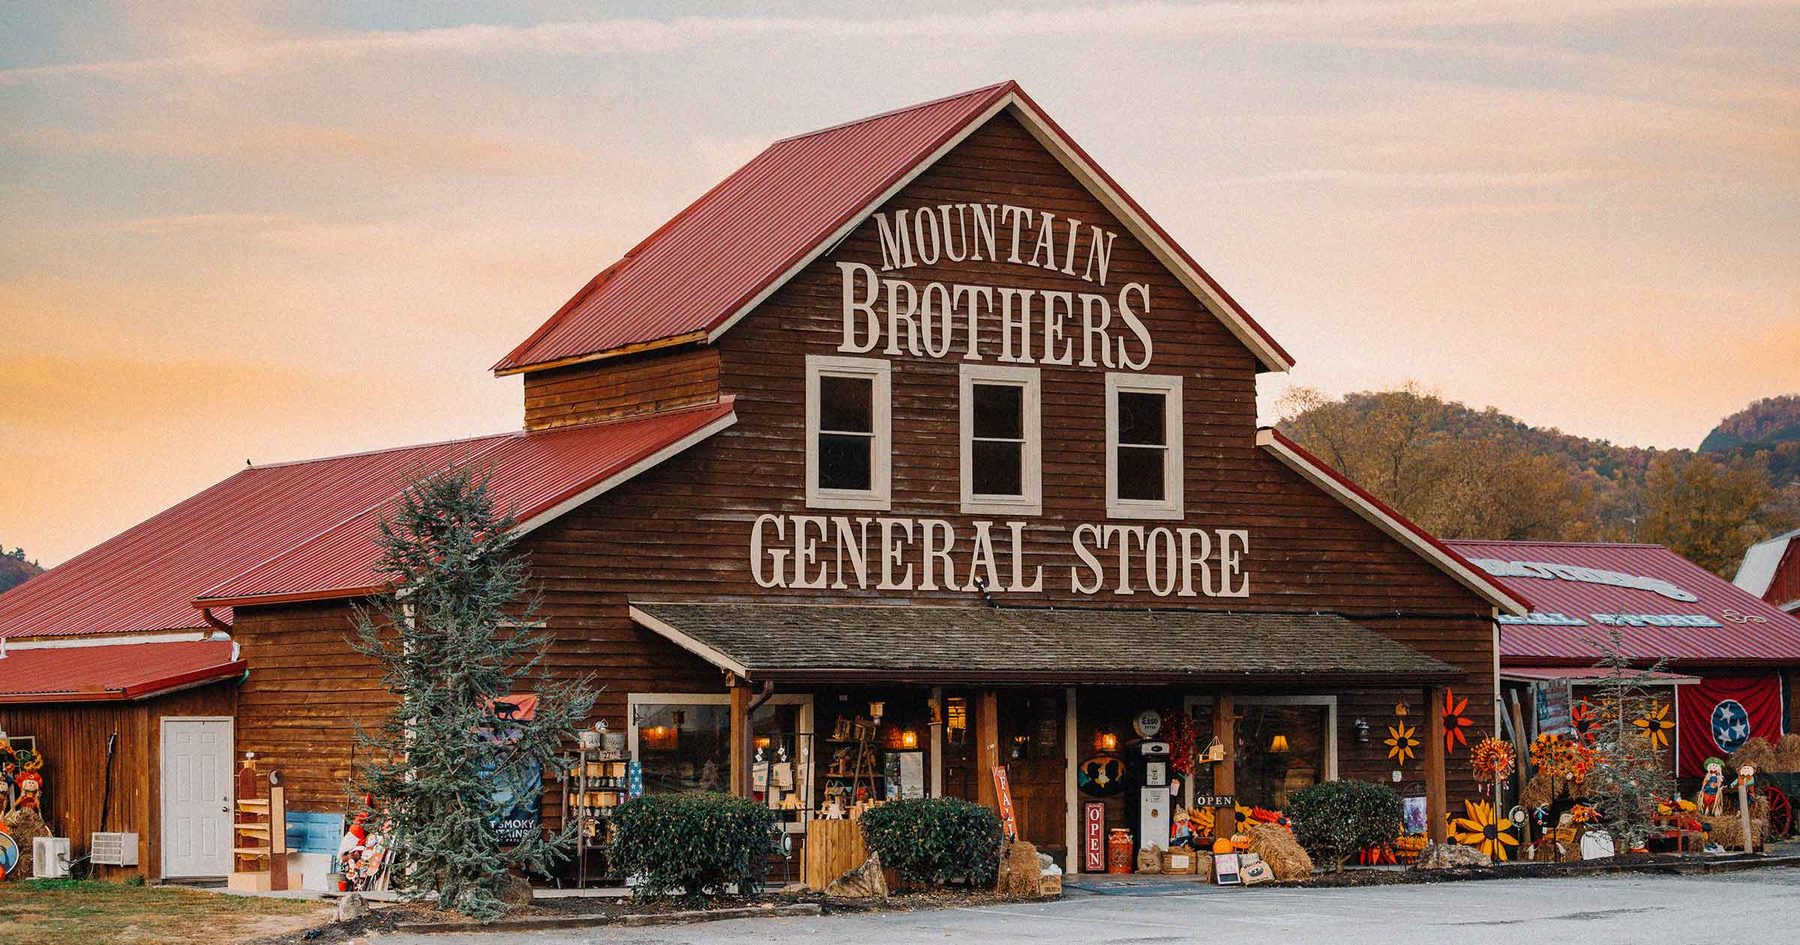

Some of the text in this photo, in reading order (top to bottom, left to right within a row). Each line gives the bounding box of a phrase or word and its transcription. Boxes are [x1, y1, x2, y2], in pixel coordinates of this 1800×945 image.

[873, 203, 1118, 287] MOUNTAIN
[836, 261, 1154, 371] BROTHERS
[750, 513, 1250, 598] GENERAL STORE
[1090, 808, 1100, 865] OPEN
[1197, 796, 1232, 805] OPEN
